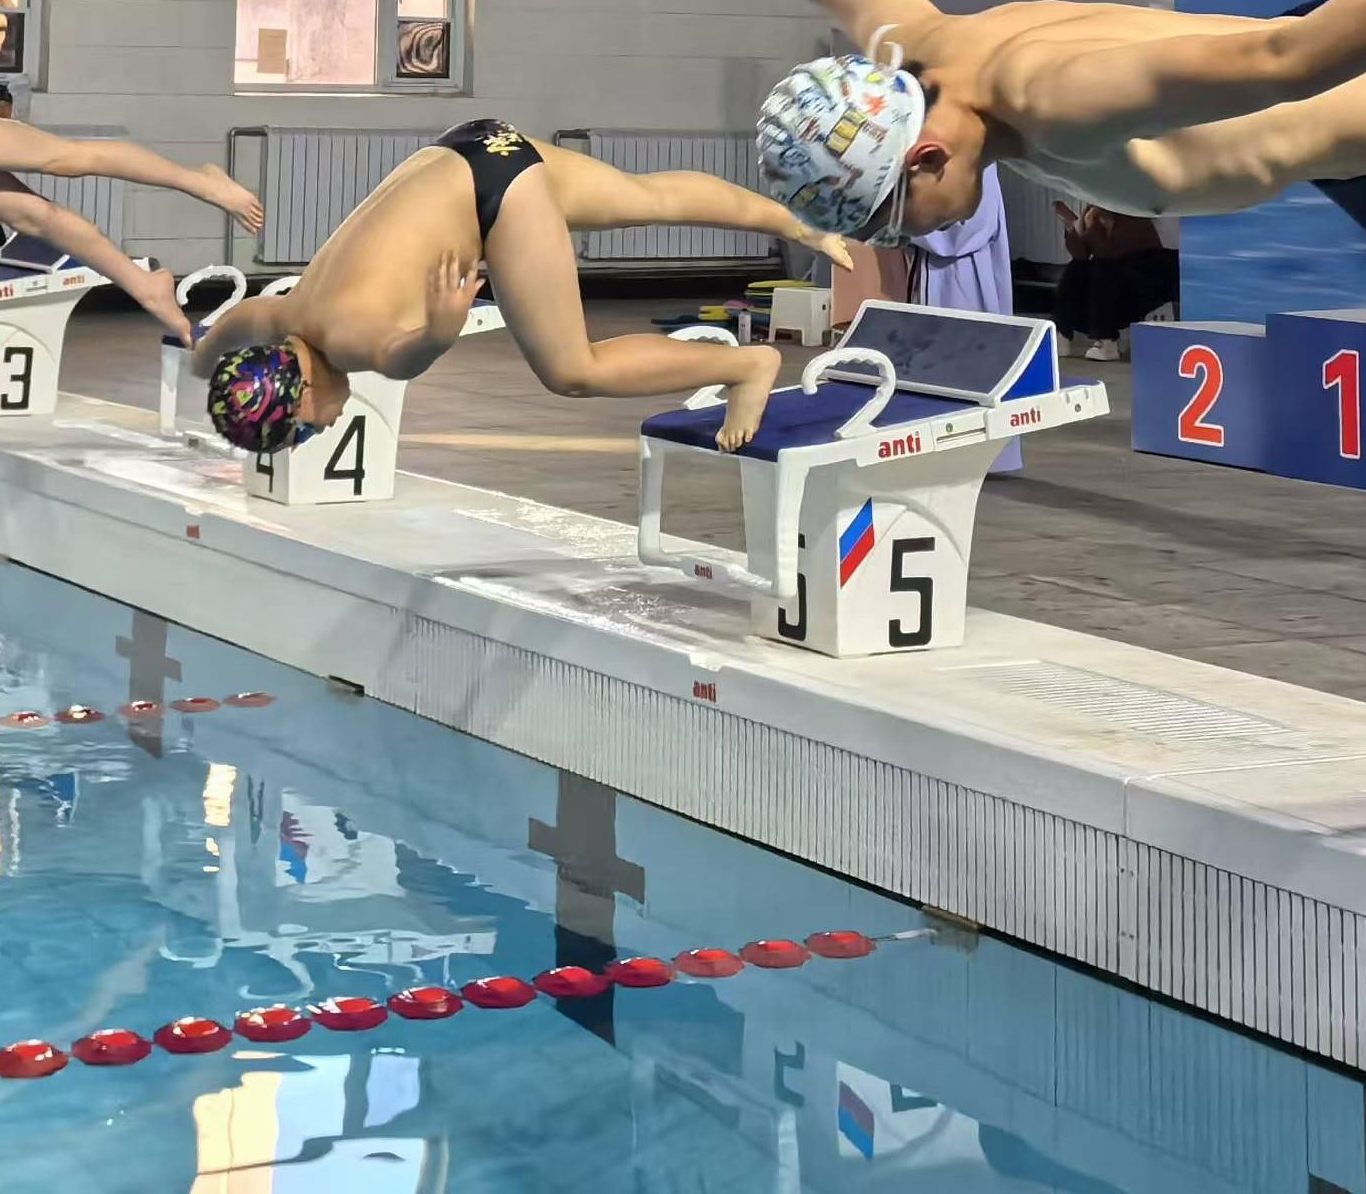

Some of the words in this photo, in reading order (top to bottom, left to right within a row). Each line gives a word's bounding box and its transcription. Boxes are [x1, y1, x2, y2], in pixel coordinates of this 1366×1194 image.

[62, 274, 85, 287] anti
[0, 346, 34, 410] 3
[1178, 345, 1224, 447] 2
[1010, 407, 1042, 428] anti
[1322, 349, 1361, 460] 1
[323, 415, 367, 496] 4
[877, 431, 922, 459] anti
[694, 562, 714, 580] anti
[889, 537, 936, 648] 5
[692, 679, 717, 704] anti
